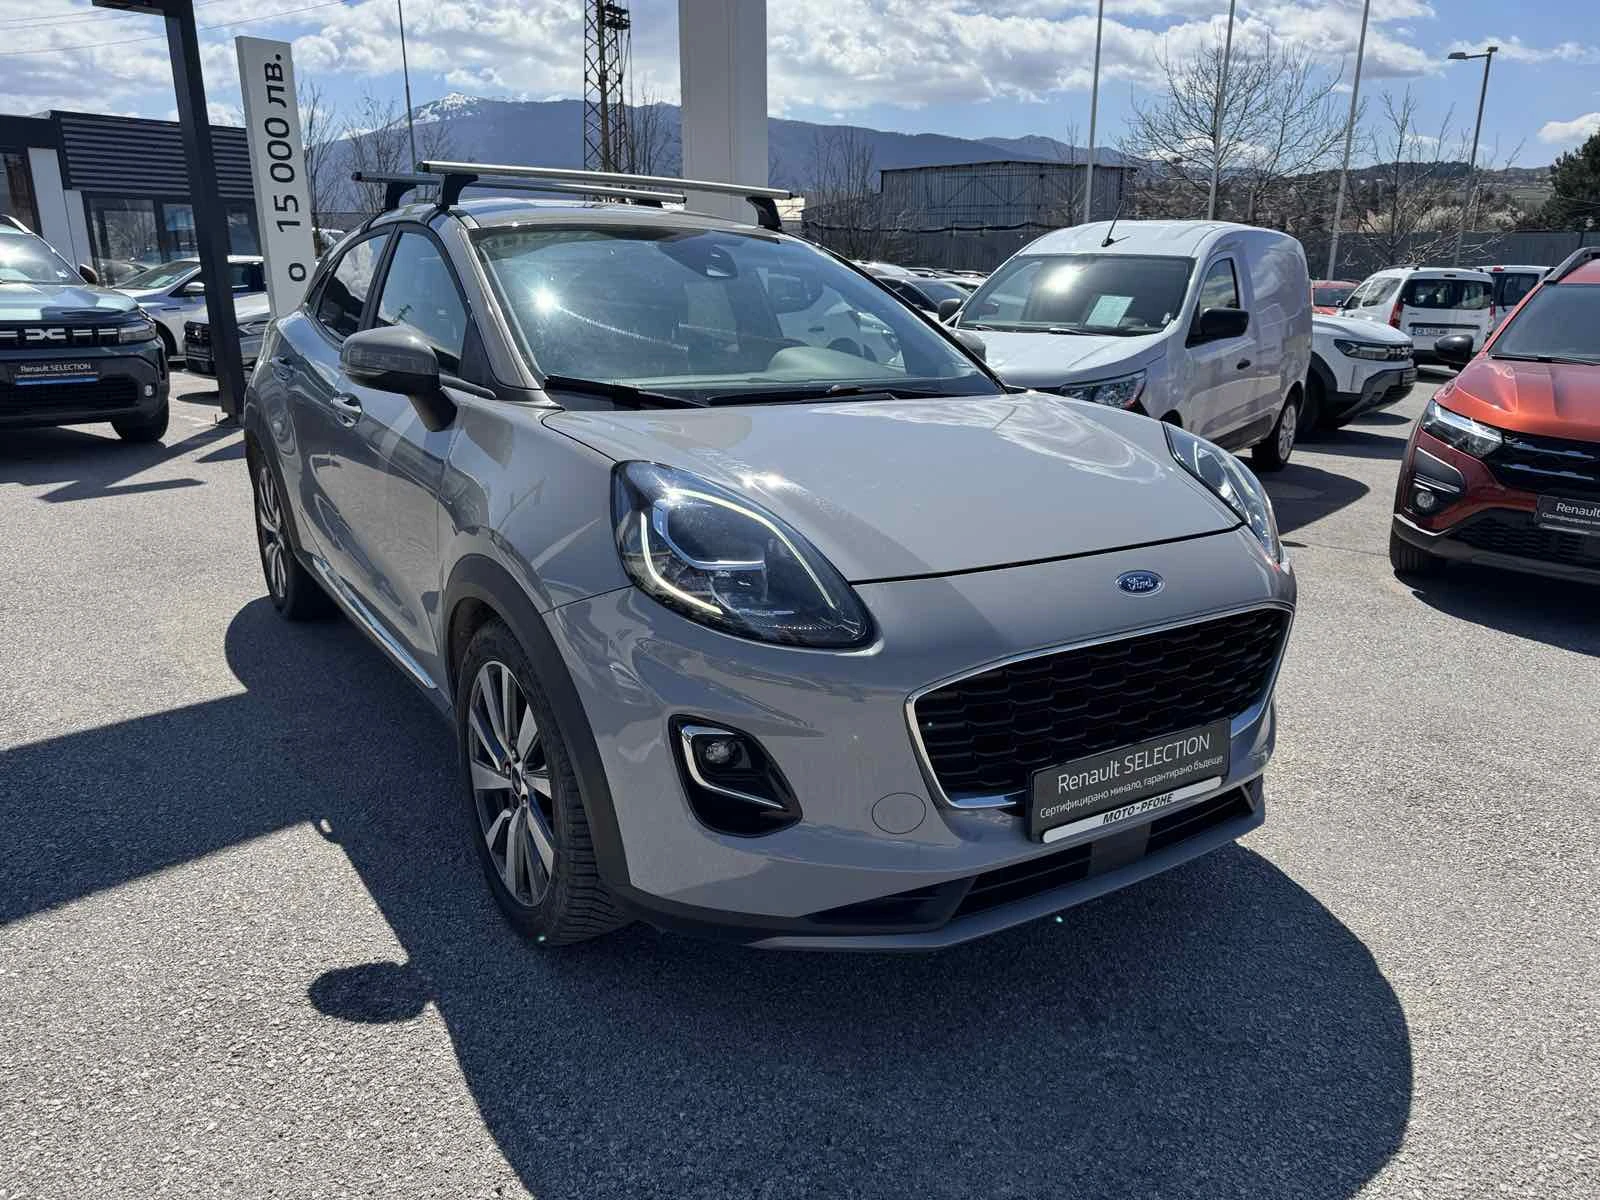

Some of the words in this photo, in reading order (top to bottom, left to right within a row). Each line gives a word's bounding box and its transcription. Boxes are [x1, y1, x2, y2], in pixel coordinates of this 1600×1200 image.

[264, 117, 296, 184] 000
[274, 195, 301, 233] 15
[20, 364, 49, 373] Renault
[50, 362, 92, 372] SELECTION
[1040, 790, 1109, 819] Сертифицирано
[1110, 780, 1143, 797] минало,
[1143, 766, 1193, 788] гарантирано
[1193, 754, 1224, 770] бъдеще
[1057, 760, 1120, 795] Renault
[1124, 732, 1211, 775] SELECTION
[1102, 793, 1175, 825] MOTO-PFOHE
